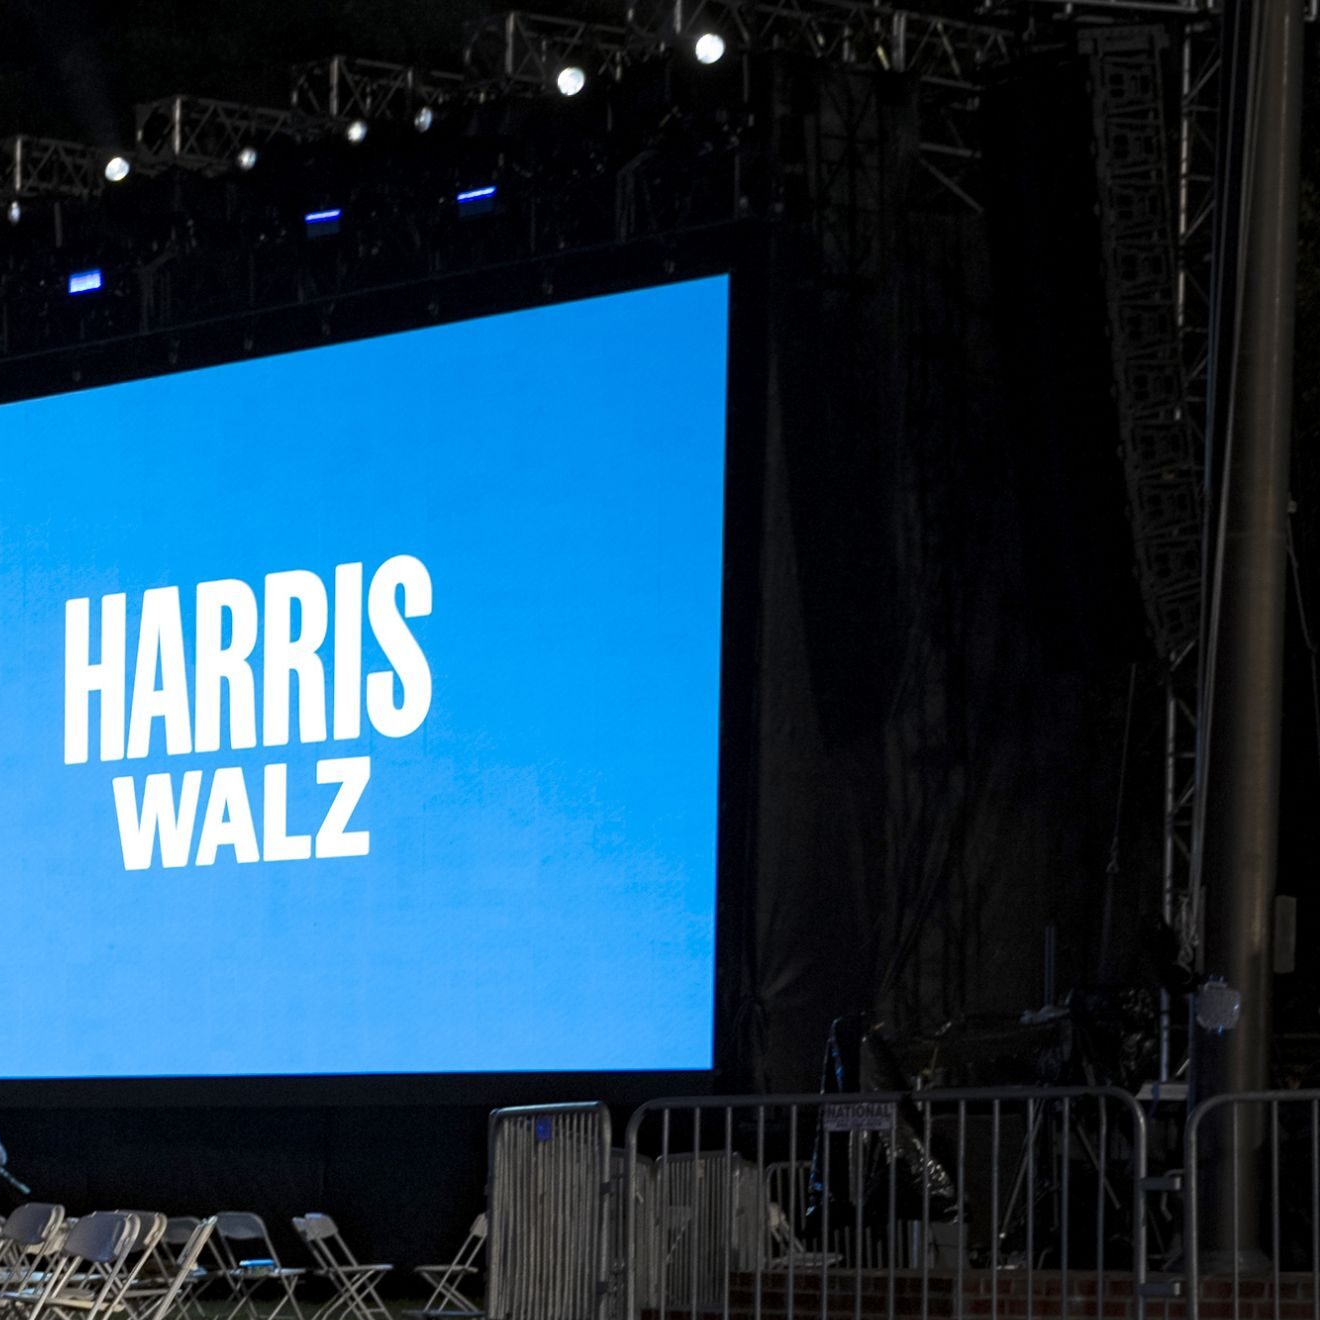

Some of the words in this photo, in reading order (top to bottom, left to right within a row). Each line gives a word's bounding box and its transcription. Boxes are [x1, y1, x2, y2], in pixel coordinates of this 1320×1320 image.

[63, 554, 433, 765] HARRIS
[111, 755, 372, 871] WALZ
[826, 1103, 892, 1118] NATIONAL
